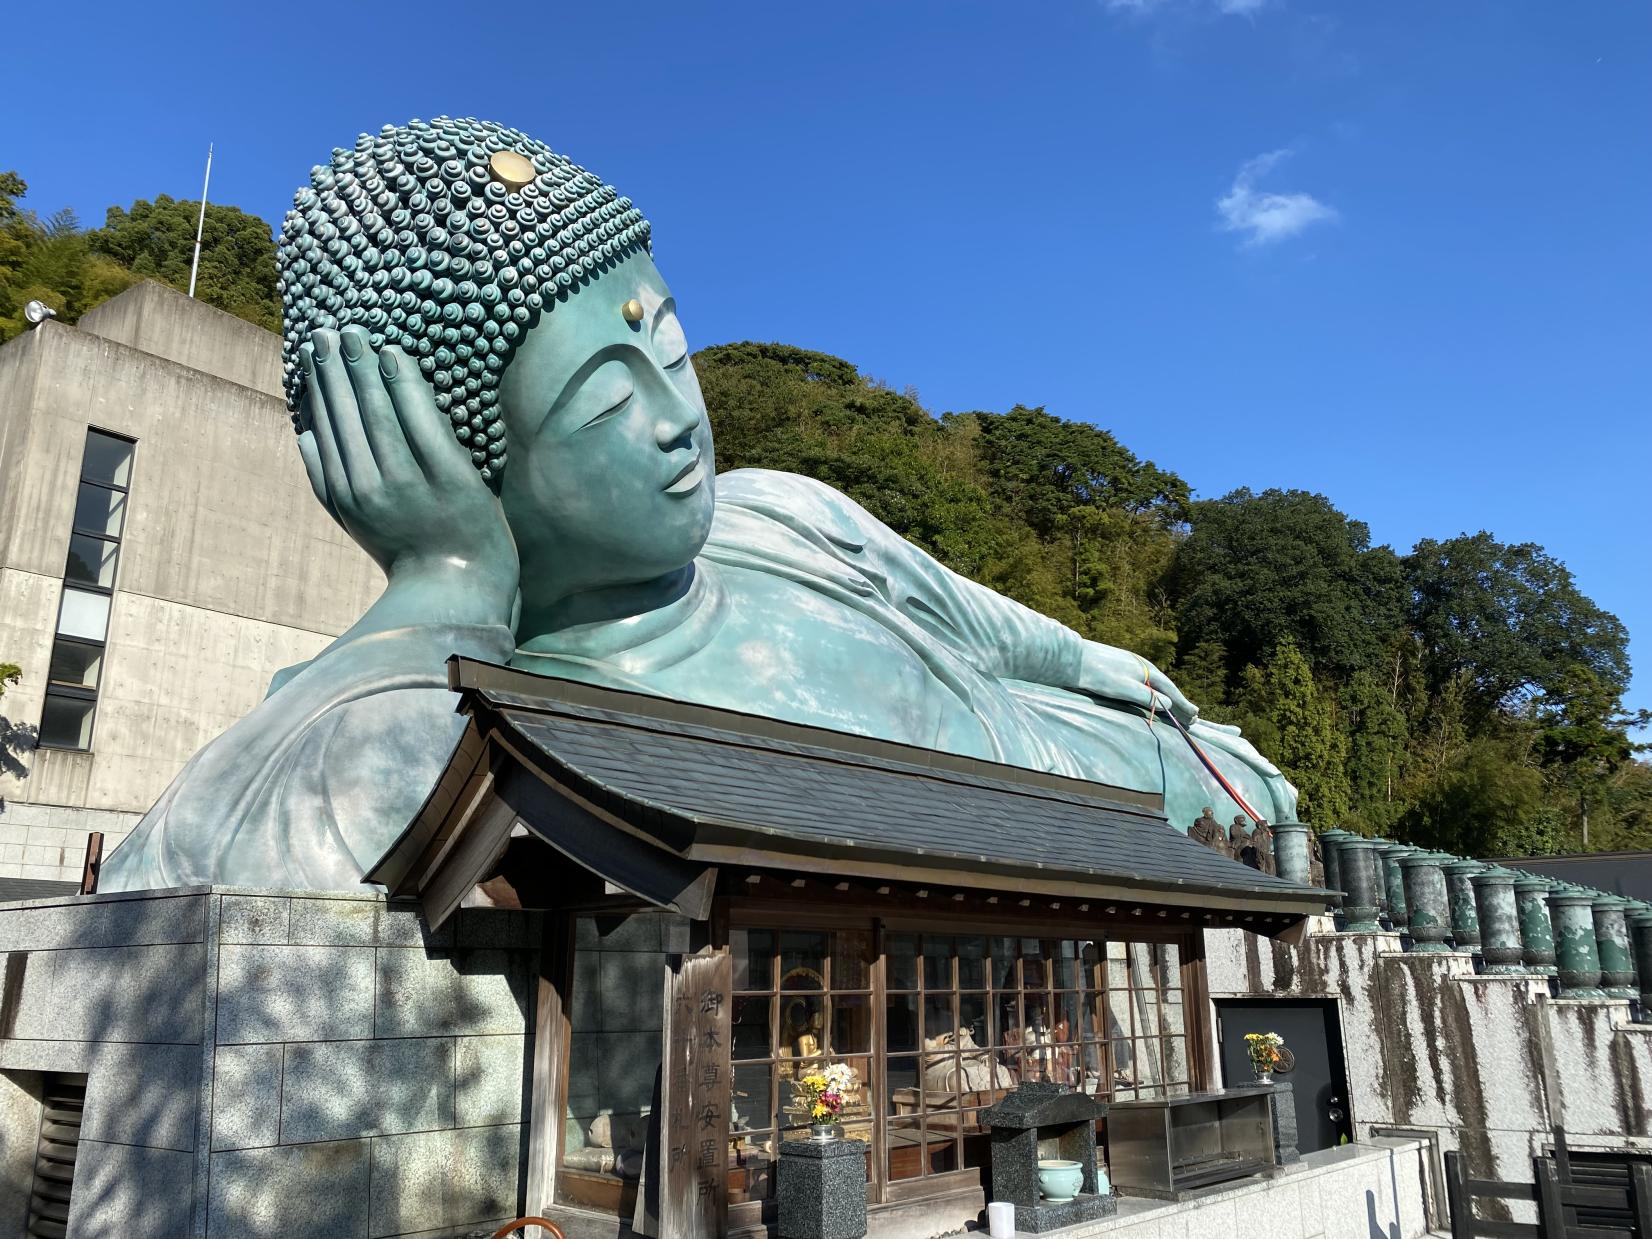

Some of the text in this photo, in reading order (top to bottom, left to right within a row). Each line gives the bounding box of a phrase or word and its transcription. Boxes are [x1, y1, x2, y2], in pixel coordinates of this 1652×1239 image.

[697, 989, 723, 1206] 御本尊安置所
